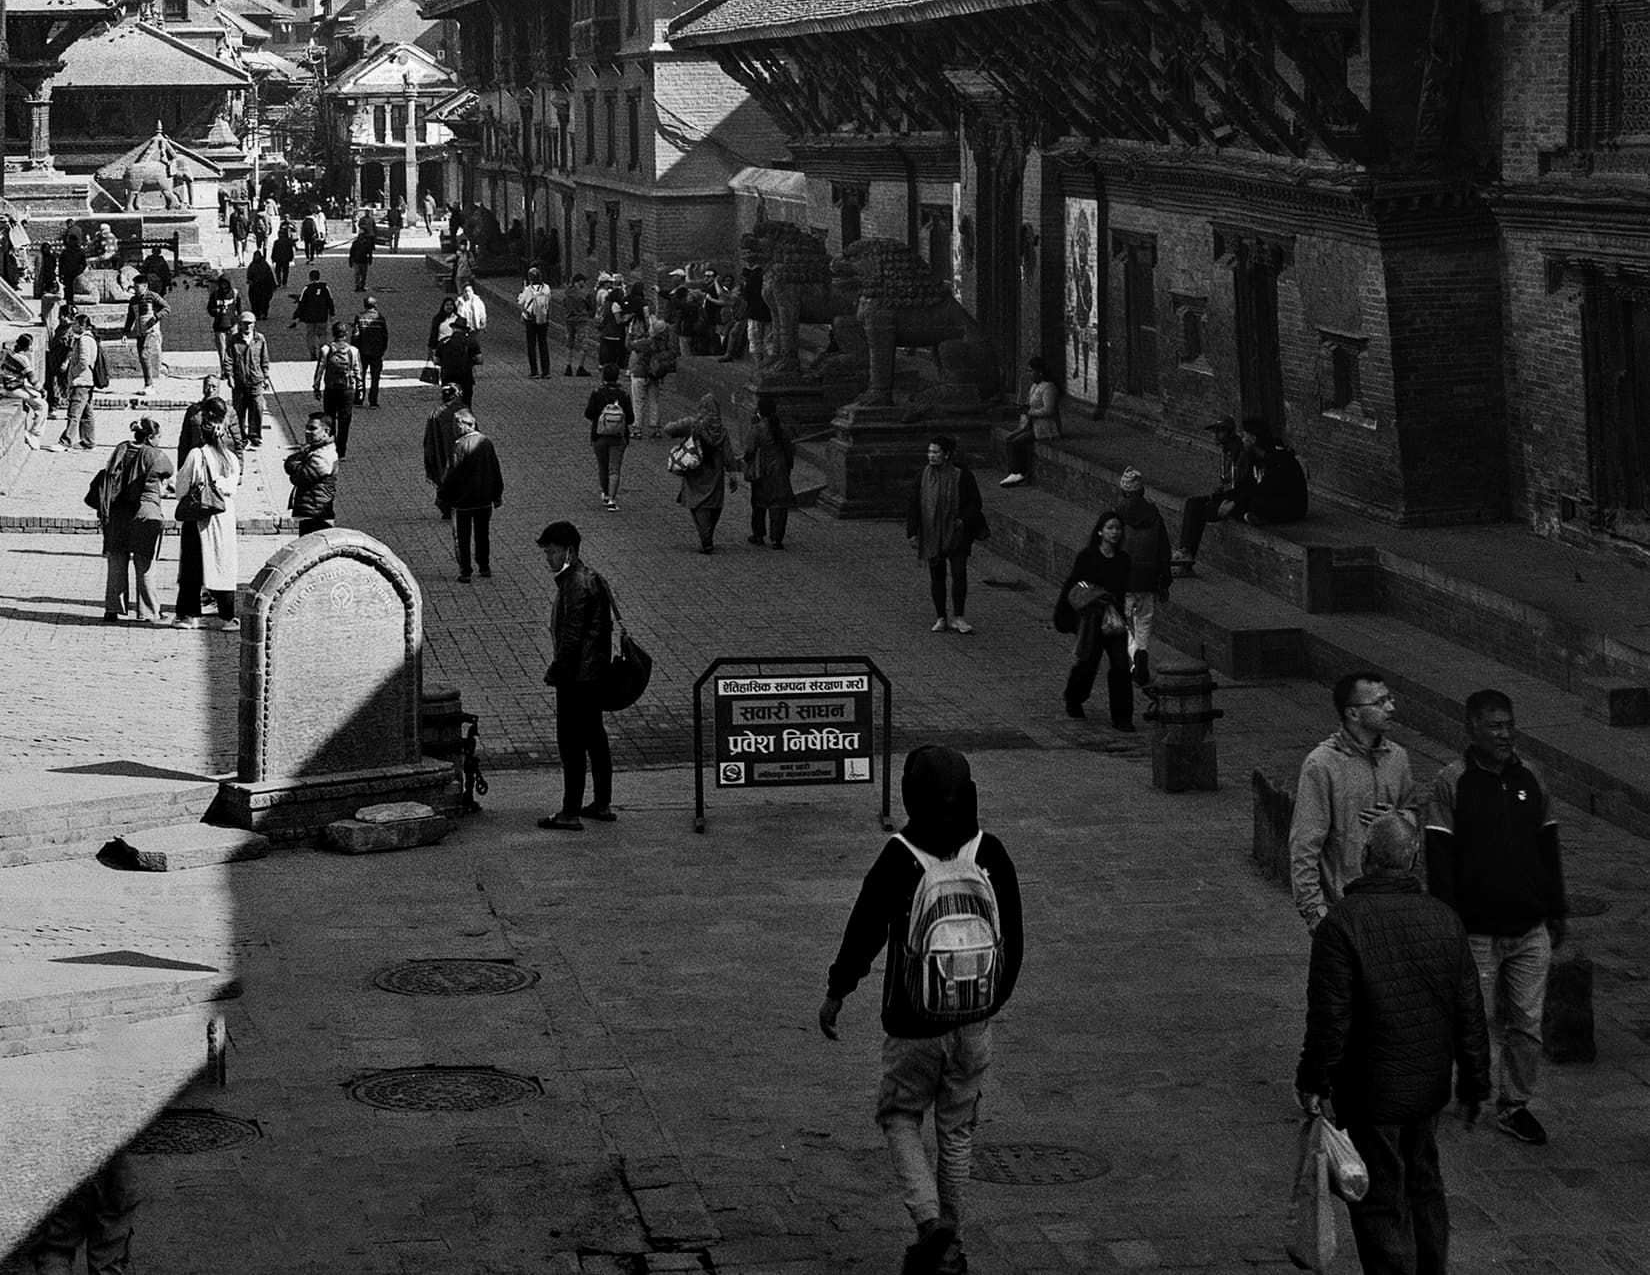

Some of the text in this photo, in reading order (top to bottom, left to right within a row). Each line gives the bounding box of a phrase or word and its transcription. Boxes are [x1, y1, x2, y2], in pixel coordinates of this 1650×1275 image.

[722, 680, 771, 693] ऐतिहासिक
[774, 682, 806, 692] सम्पदा
[808, 679, 843, 691] संरक्षण
[740, 701, 846, 720] सवारी साधन
[728, 727, 861, 756] प्रवेश निषेधित
